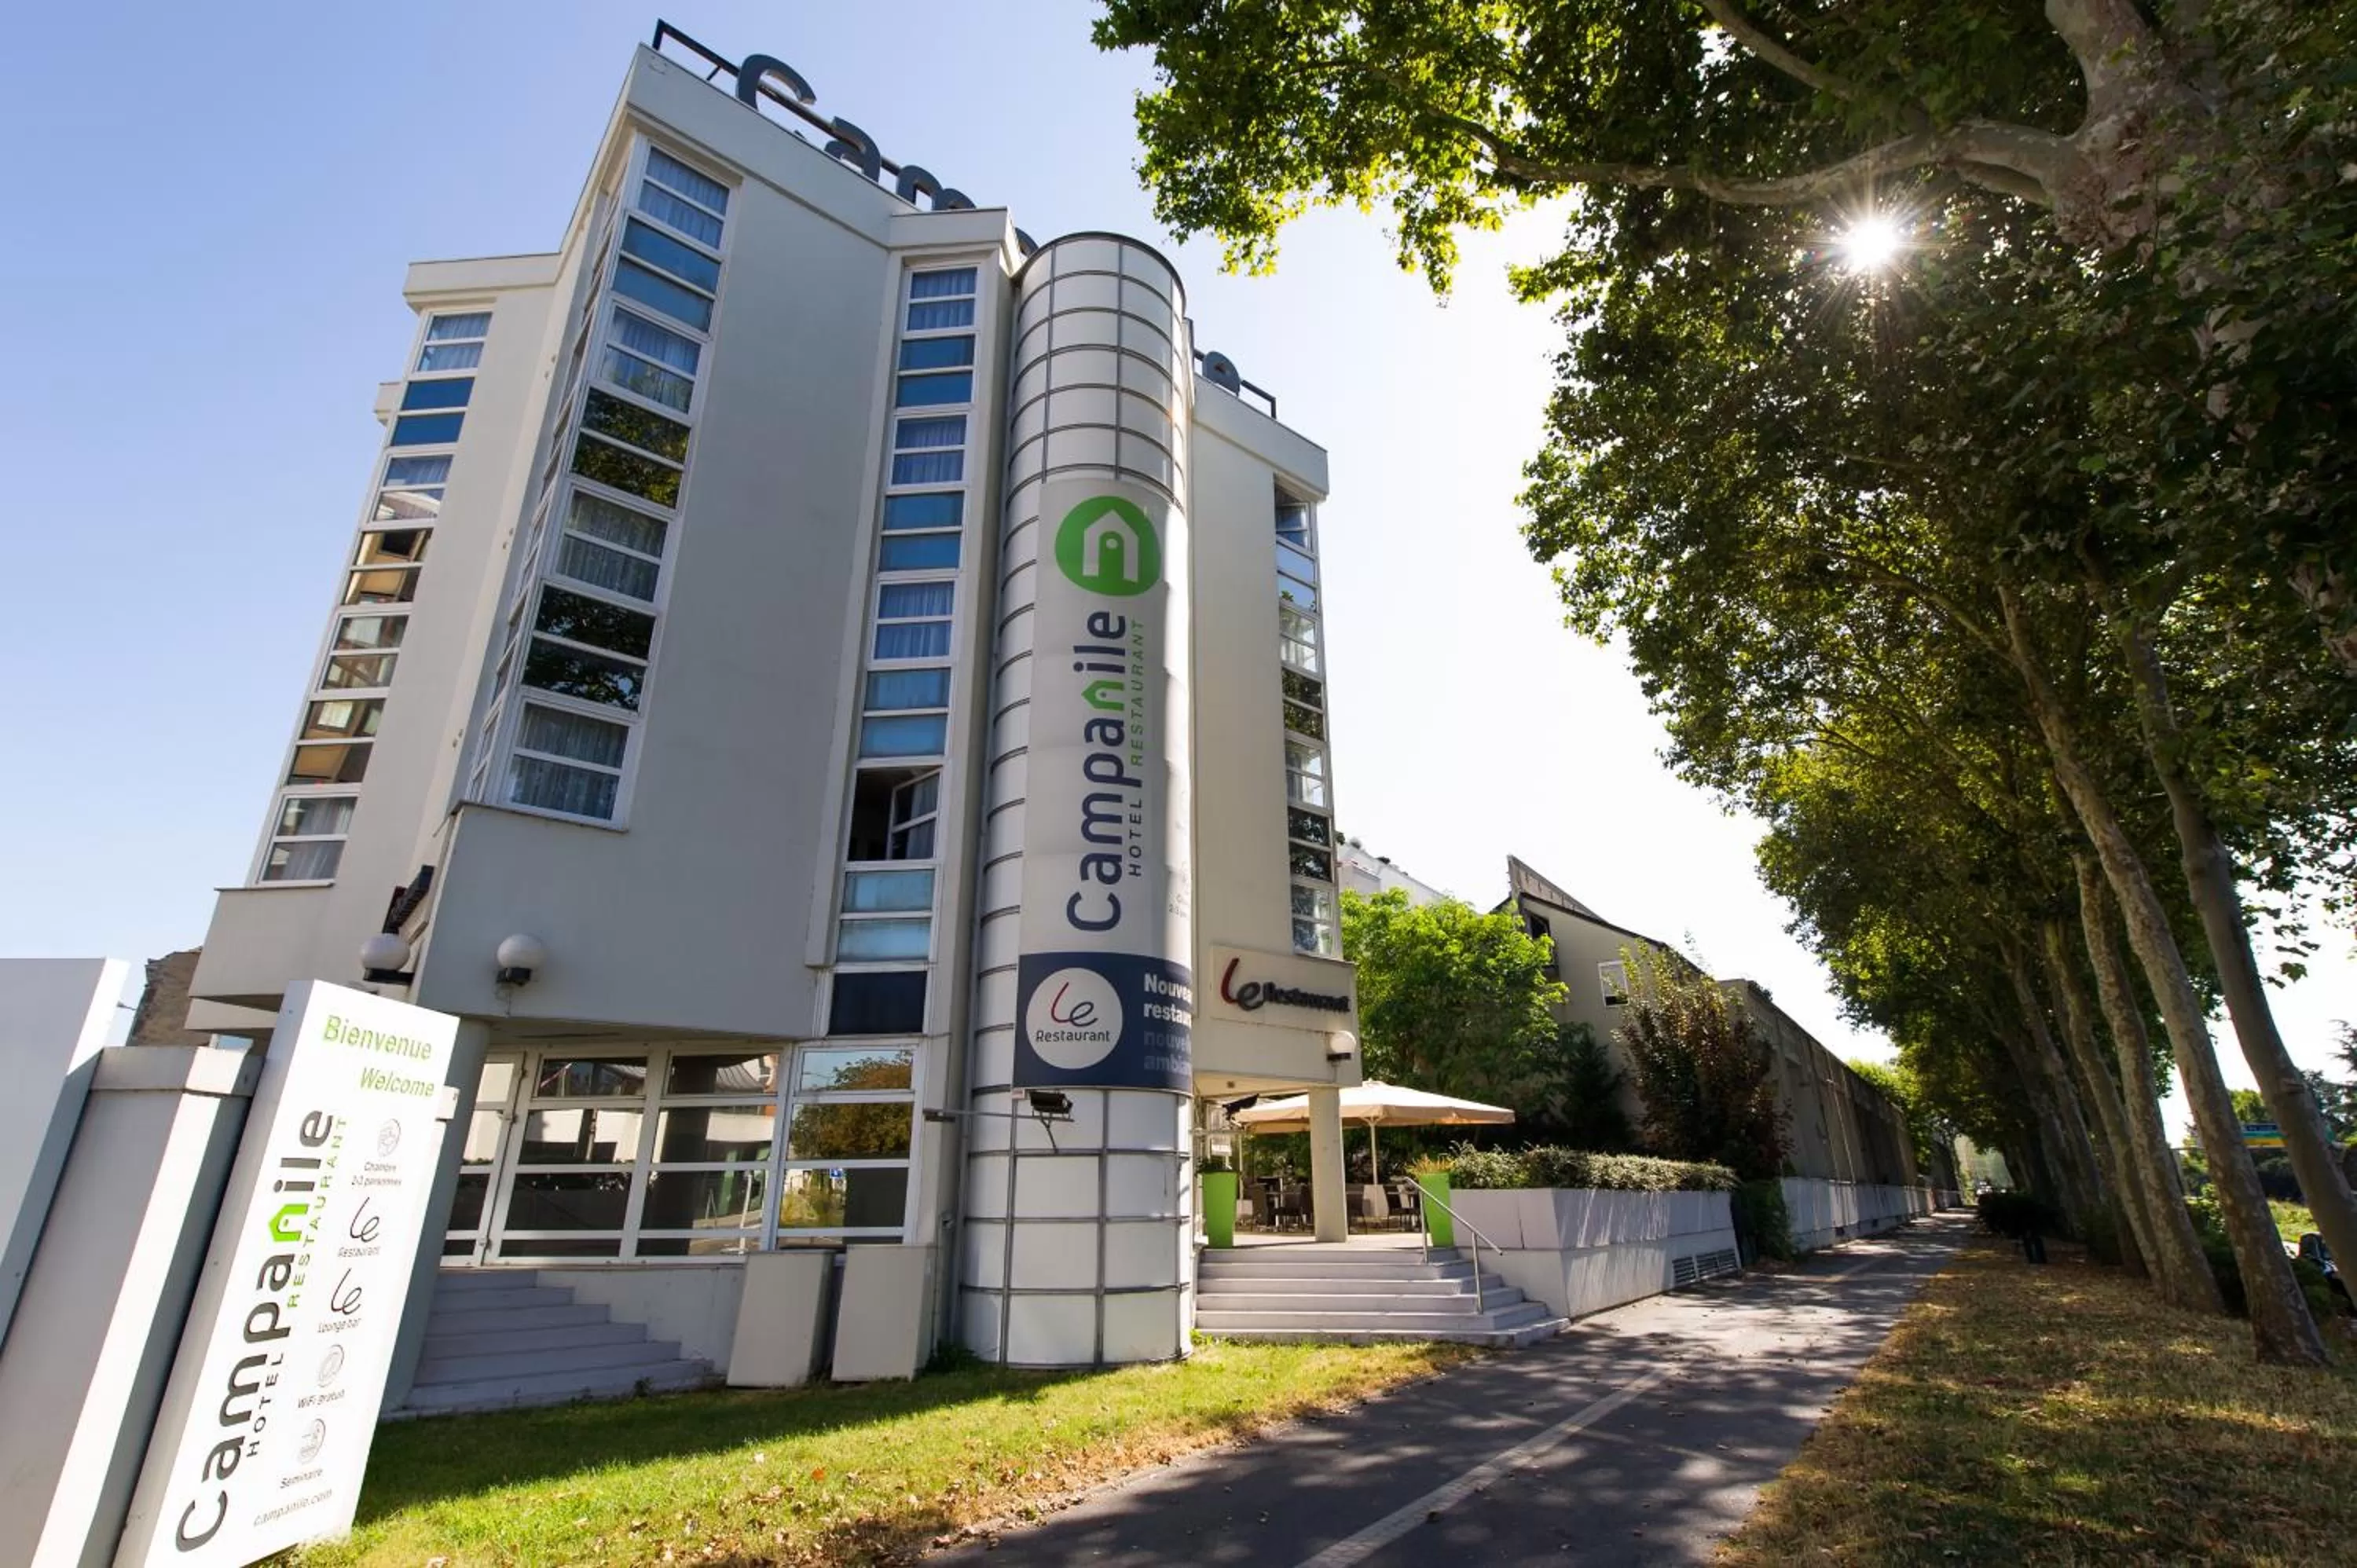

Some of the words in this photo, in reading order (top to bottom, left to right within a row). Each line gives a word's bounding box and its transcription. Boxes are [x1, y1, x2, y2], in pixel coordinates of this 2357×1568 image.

[1131, 619, 1144, 767] RESTAURANT
[1066, 610, 1142, 932] Campanile
[1128, 798, 1142, 877] HOTEL
[1050, 982, 1099, 1028] Le
[1221, 958, 1265, 1011] Le
[323, 1014, 432, 1061] Bienvenue
[1035, 1030, 1111, 1042] Restaurant
[361, 1066, 435, 1097] Welcome
[246, 1352, 284, 1458] HOTEL
[288, 1118, 346, 1308] RESTAURANT
[175, 1110, 334, 1553] Campanile
